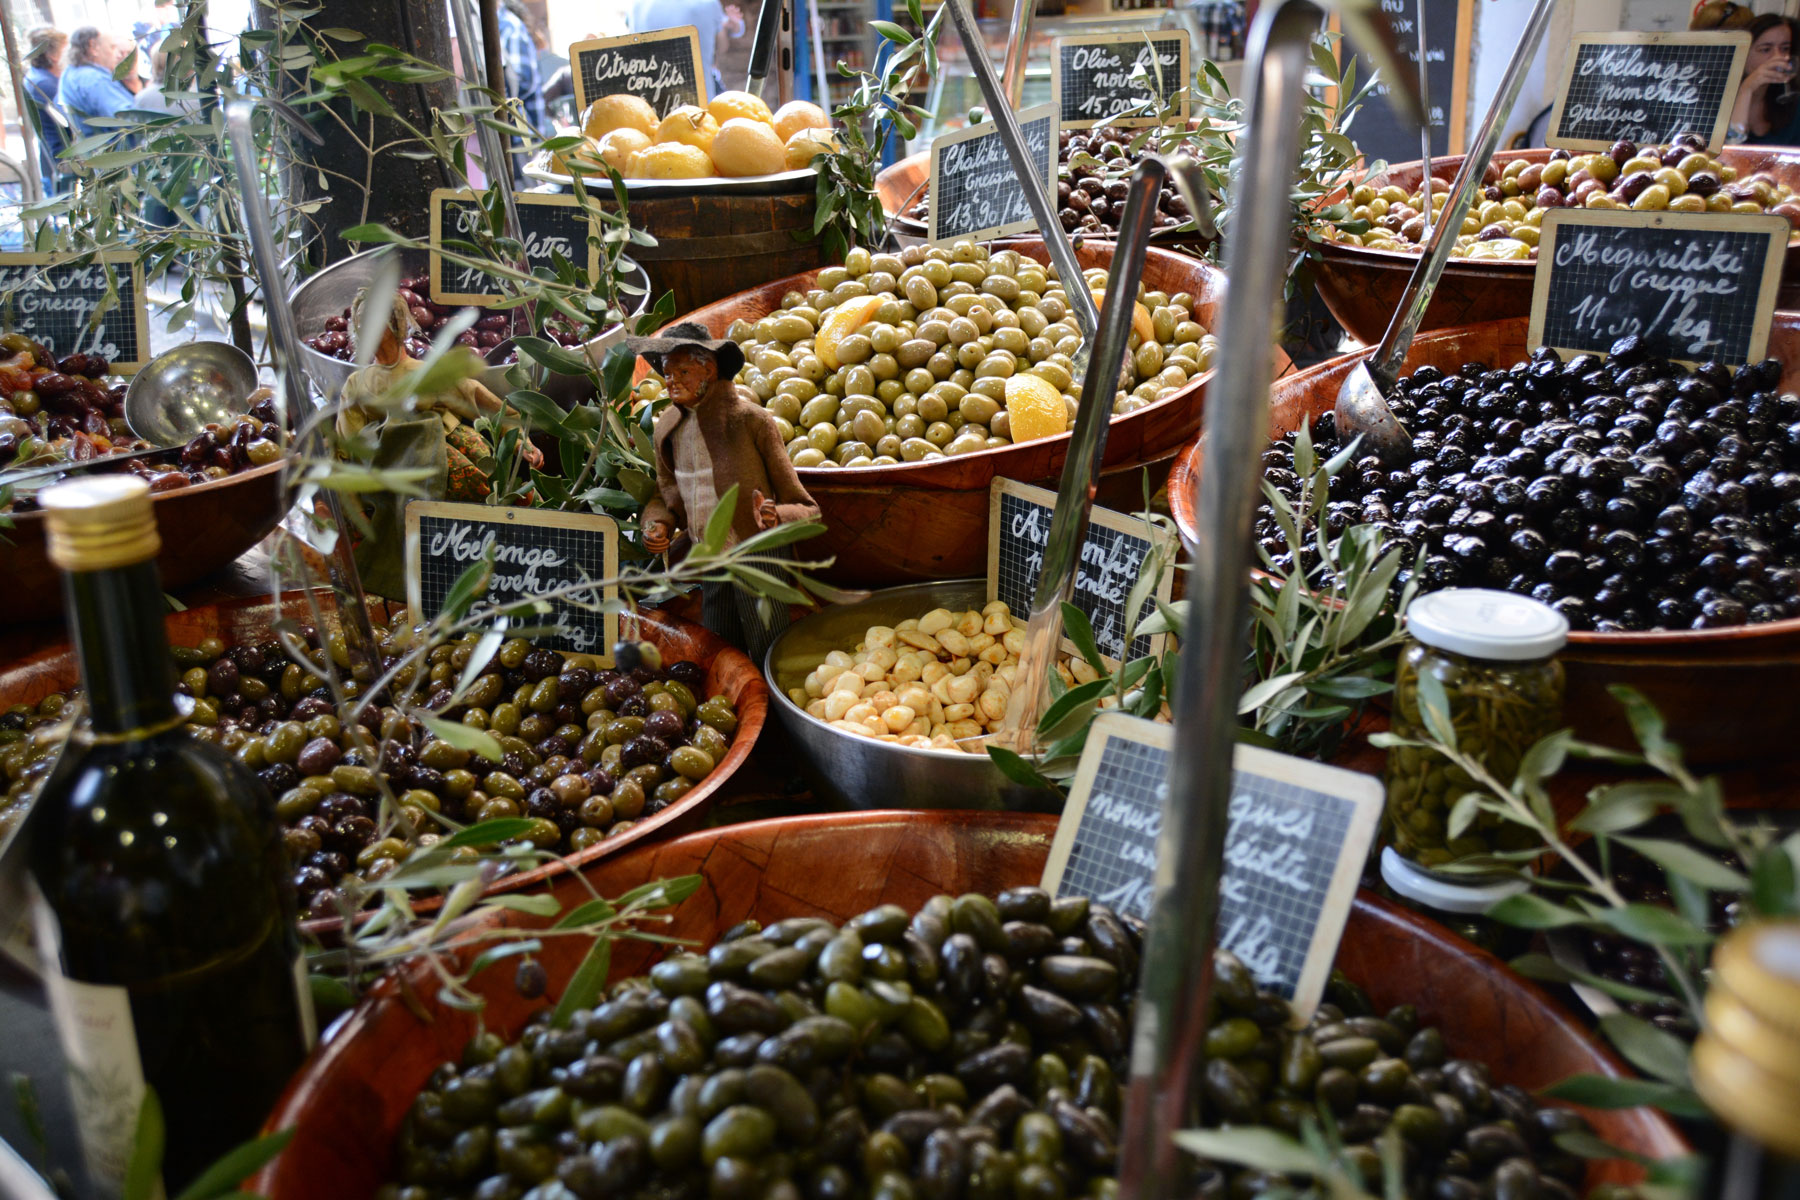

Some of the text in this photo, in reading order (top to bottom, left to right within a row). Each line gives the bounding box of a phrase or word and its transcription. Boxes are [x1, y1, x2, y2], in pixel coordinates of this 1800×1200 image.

[596, 51, 658, 81] Citrons
[1072, 47, 1121, 70] Olive
[1579, 47, 1702, 87] Mélange
[627, 61, 685, 102] confits
[1596, 75, 1709, 106] pimenté
[1555, 229, 1744, 294] Mégaritiki
[1630, 269, 1739, 304] Grecque
[430, 521, 568, 569] Mélange
